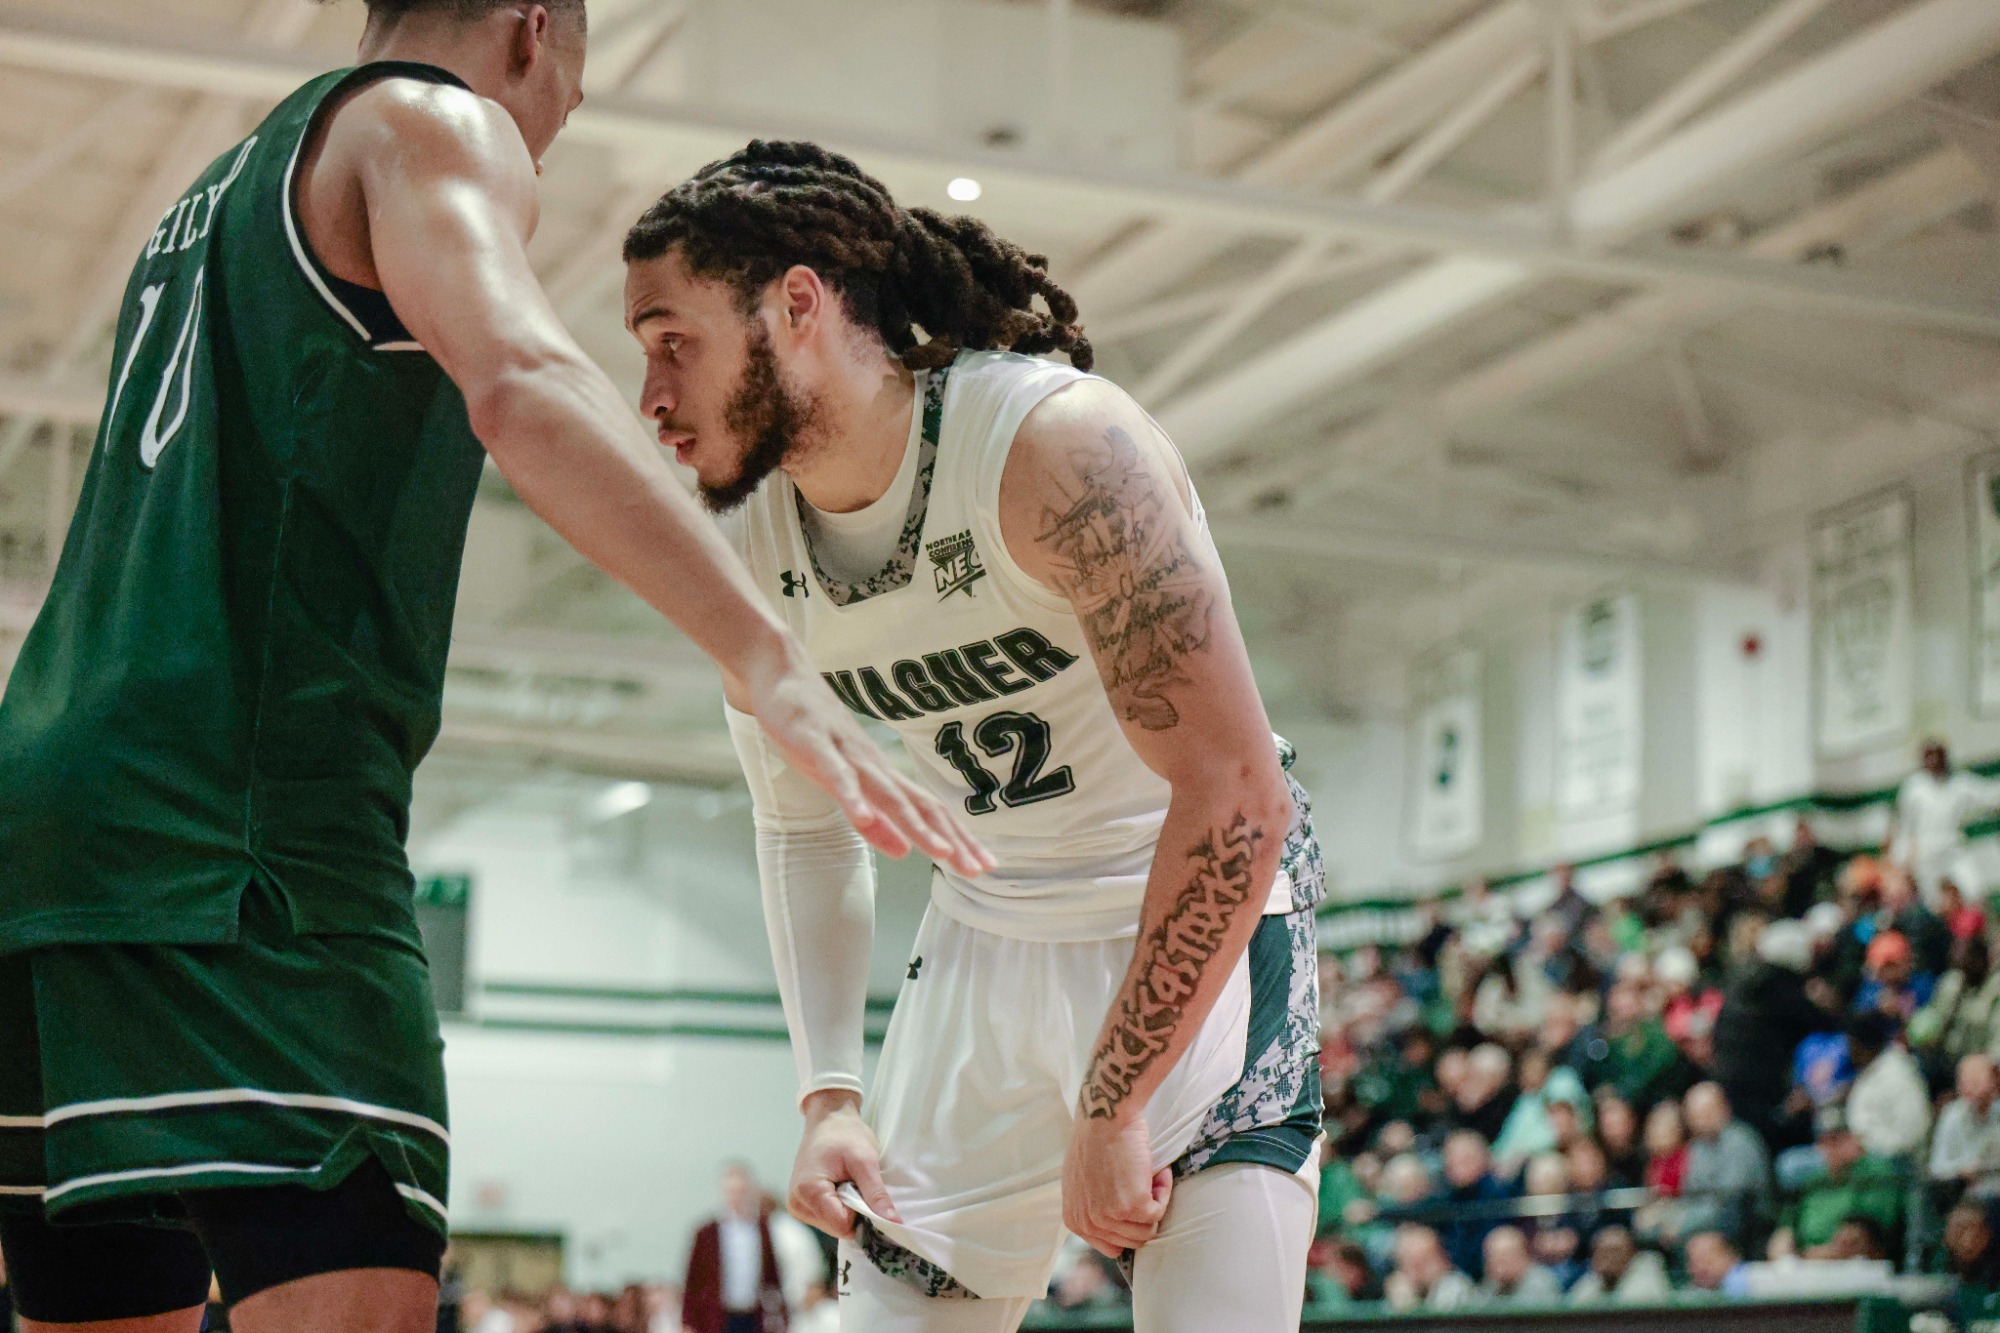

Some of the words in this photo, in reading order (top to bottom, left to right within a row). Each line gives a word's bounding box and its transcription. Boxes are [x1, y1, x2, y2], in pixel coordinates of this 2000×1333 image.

[104, 265, 204, 468] 10
[820, 627, 1079, 721] WAGNER
[934, 711, 1077, 816] 12
